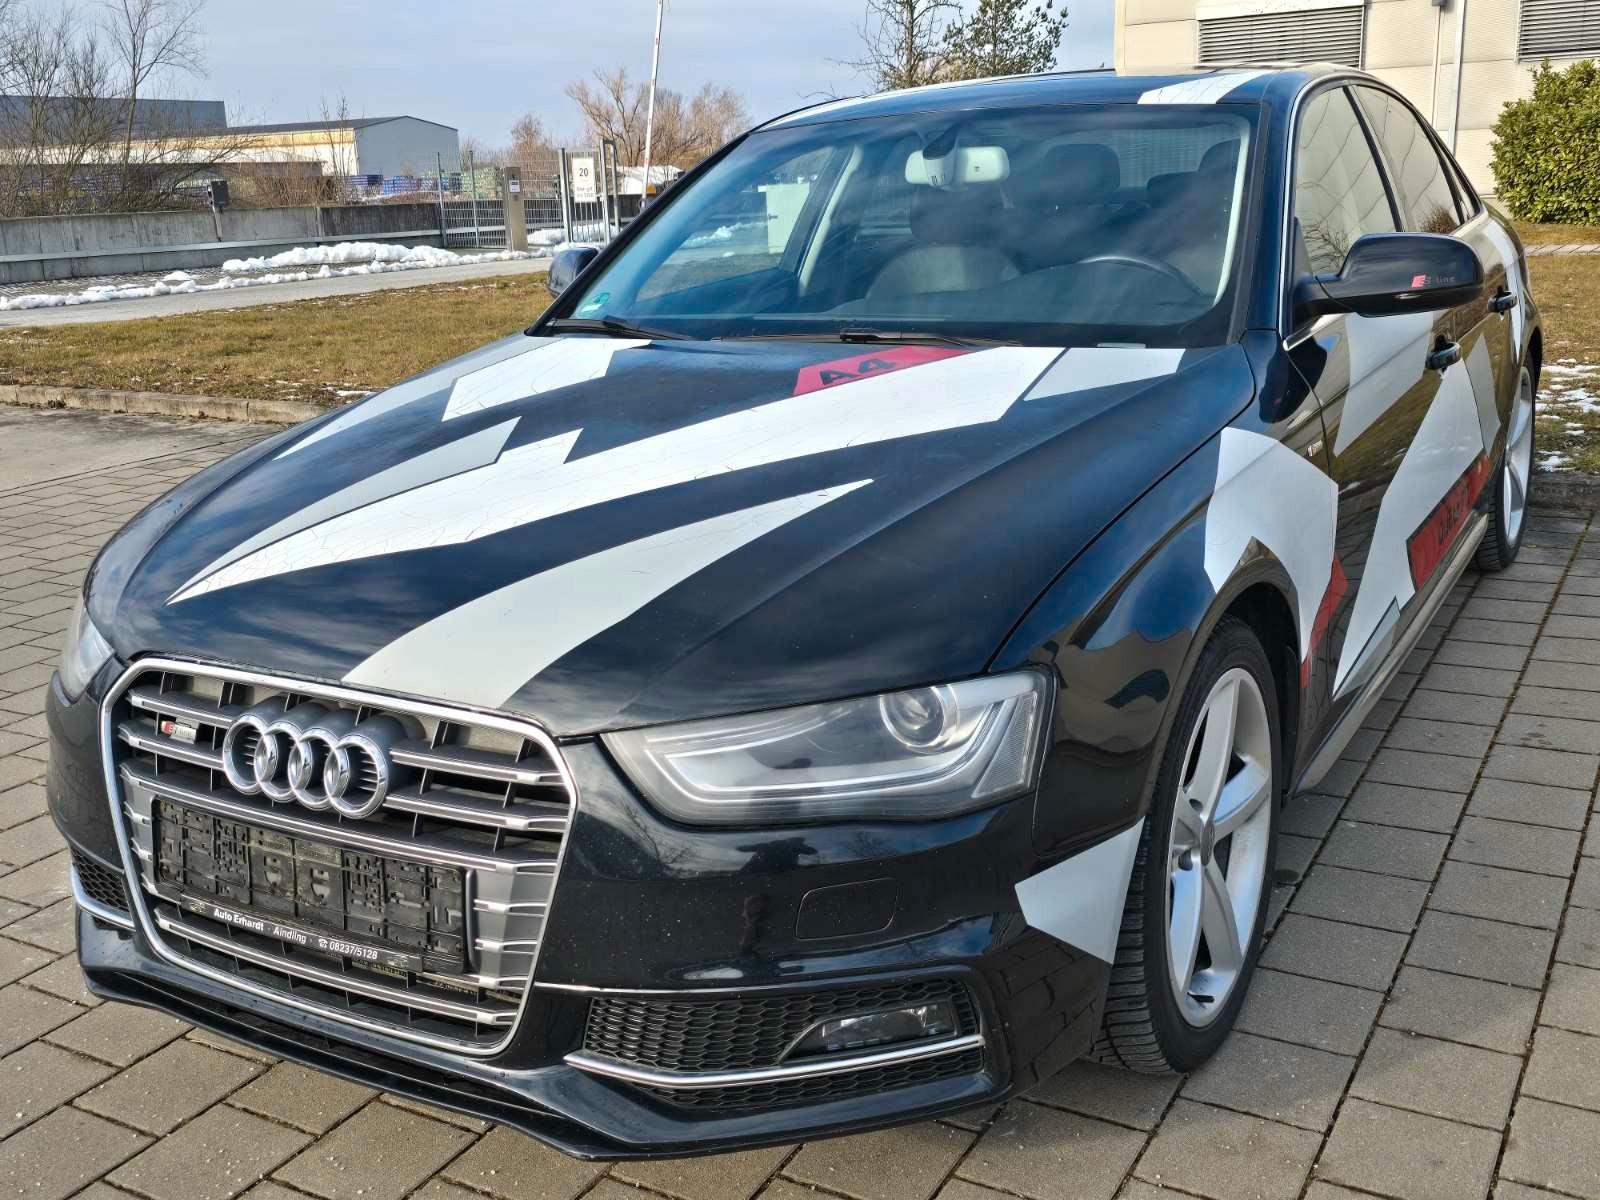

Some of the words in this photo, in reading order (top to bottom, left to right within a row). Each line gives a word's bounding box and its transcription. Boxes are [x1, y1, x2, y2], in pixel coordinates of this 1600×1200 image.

[579, 167, 589, 177] 20
[213, 908, 232, 923] Auto
[233, 913, 265, 932] Erhardt
[329, 940, 378, 961] 08237/5128
